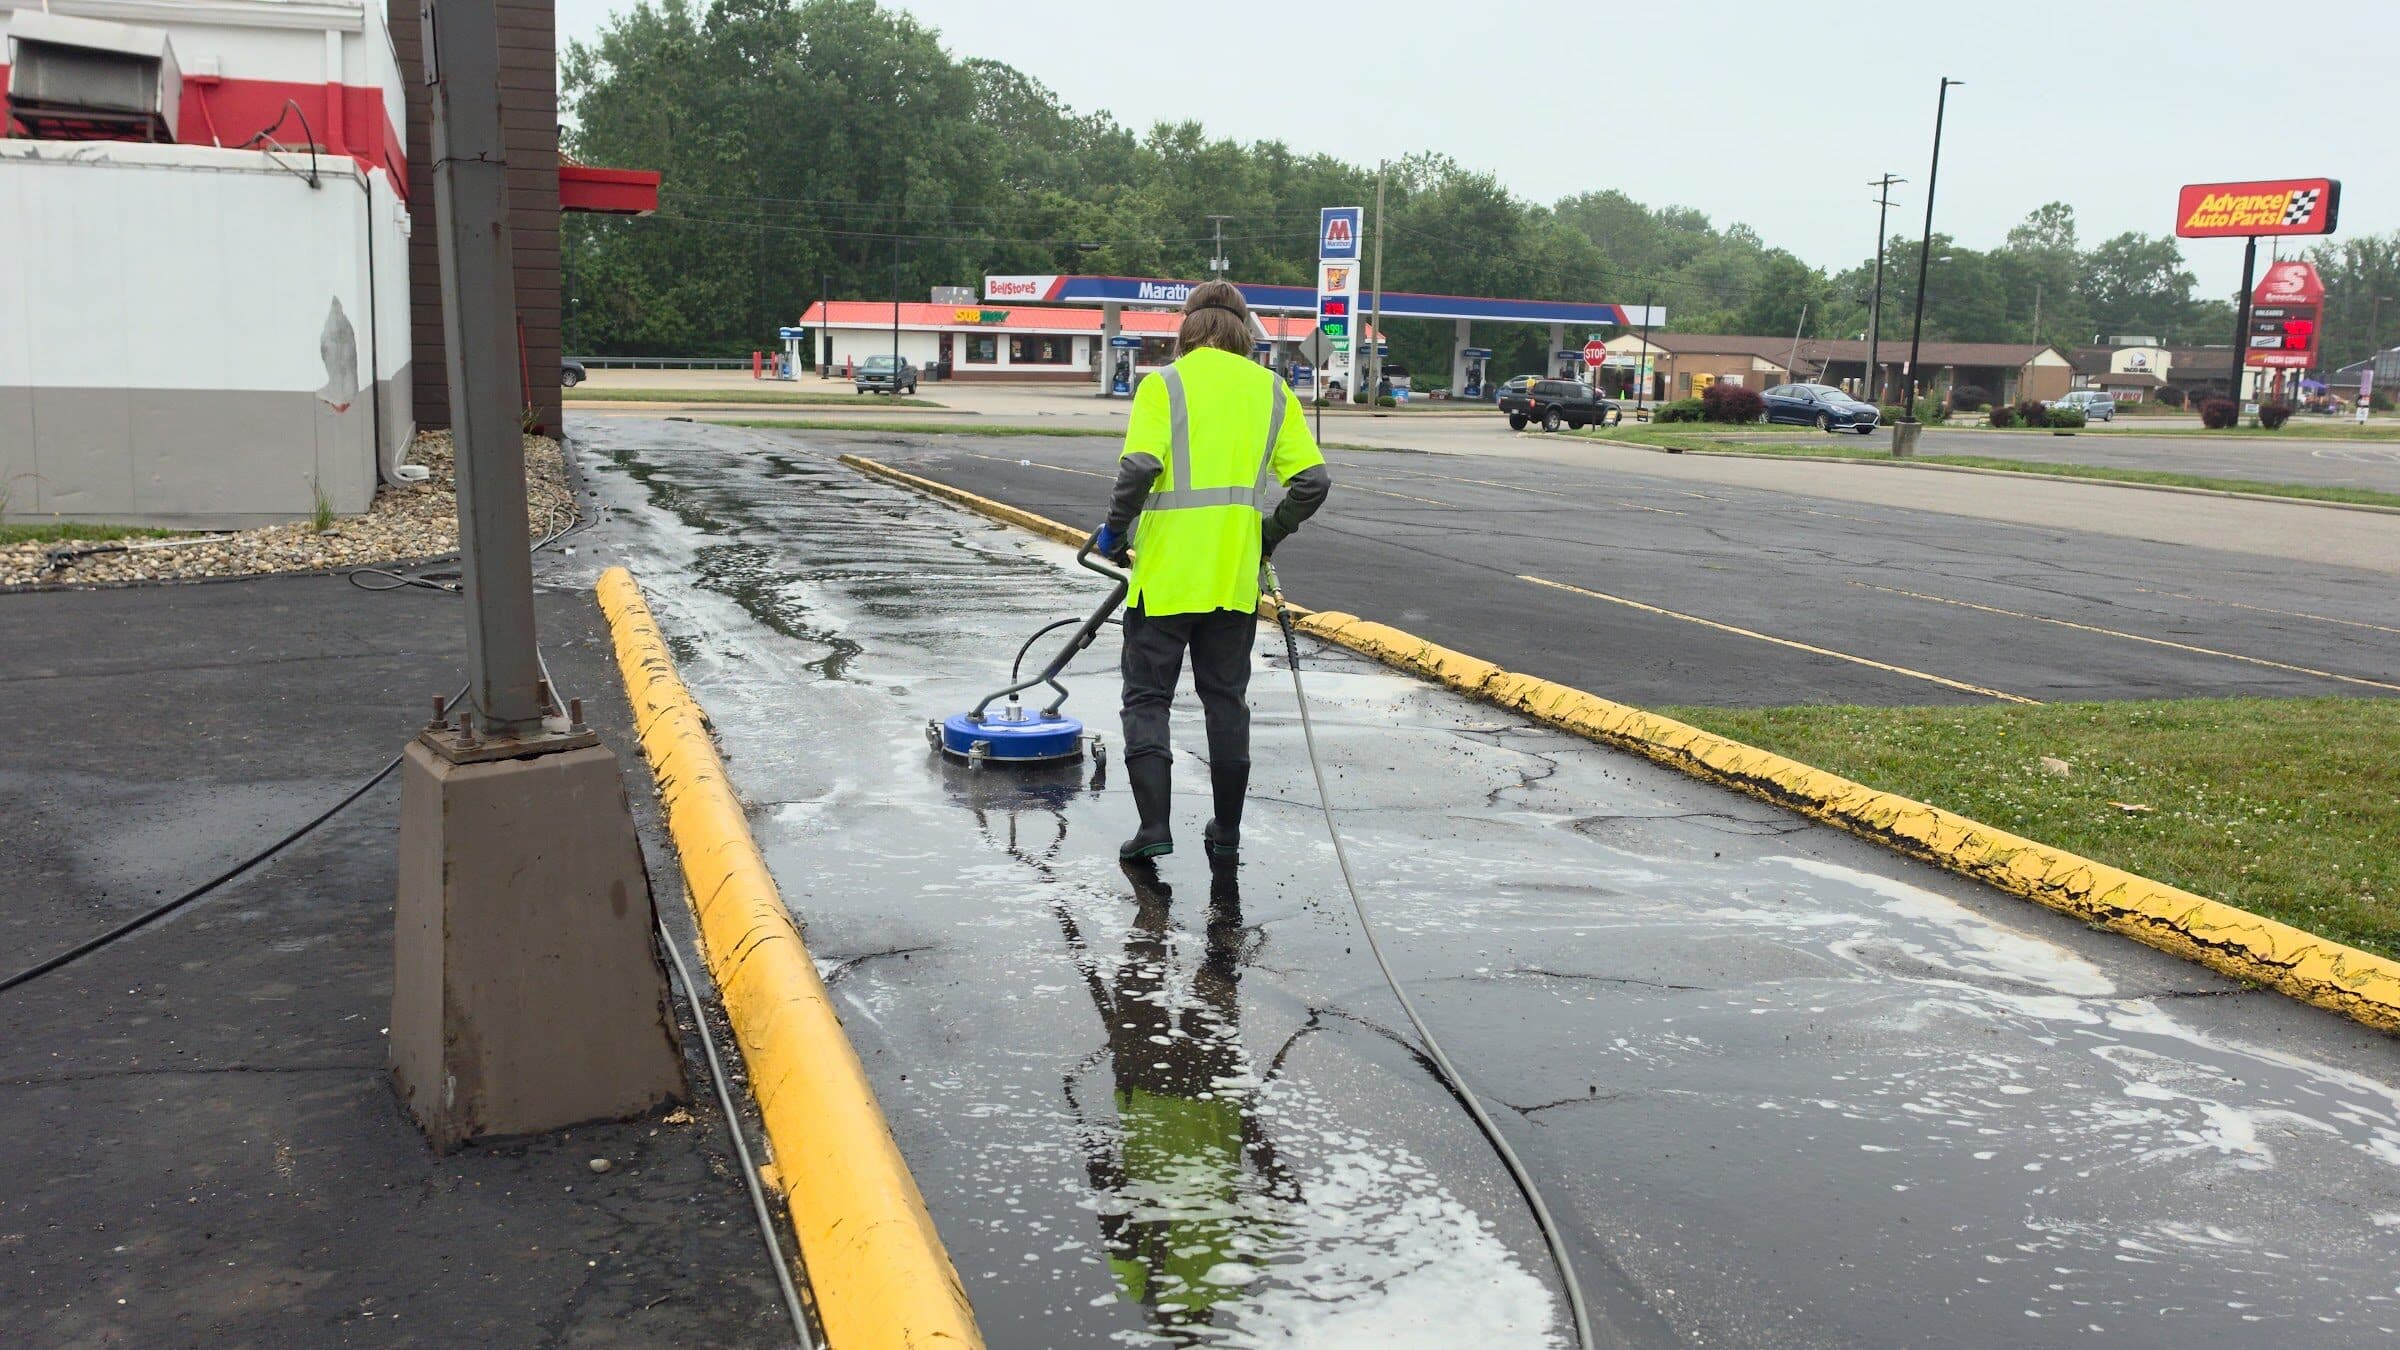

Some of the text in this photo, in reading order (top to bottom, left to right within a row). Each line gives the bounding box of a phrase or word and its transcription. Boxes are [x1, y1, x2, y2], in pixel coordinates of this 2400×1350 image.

[2198, 193, 2284, 212] Advance
[2184, 208, 2278, 228] Auto Parts
[1139, 282, 1196, 300] Marath
[954, 309, 1011, 323] SUBWAY
[1585, 348, 1606, 360] STOP
